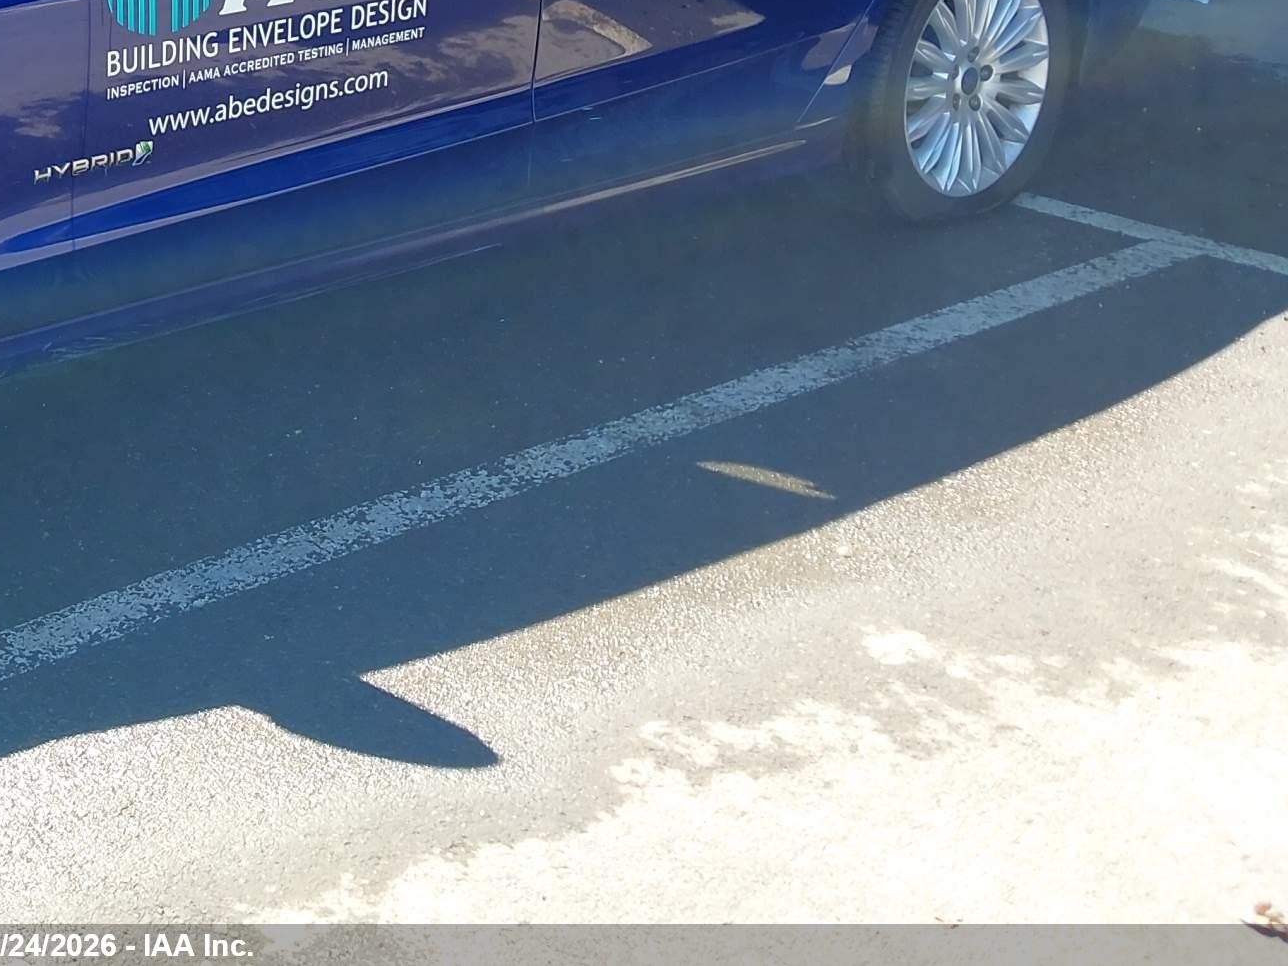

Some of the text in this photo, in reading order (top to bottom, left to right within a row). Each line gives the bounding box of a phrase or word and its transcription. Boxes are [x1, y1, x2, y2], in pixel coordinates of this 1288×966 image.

[106, 74, 180, 100] INSPECTION
[188, 66, 221, 84] AAMA
[223, 52, 295, 77] ACCREDITED
[297, 42, 344, 62] TESTING
[352, 27, 425, 51] MANAGEMENT
[107, 32, 219, 77] BUILDING
[228, 8, 343, 53] ENVELOPE
[148, 70, 388, 135] www.abedesigns.com
[34, 149, 133, 183] HYBRID
